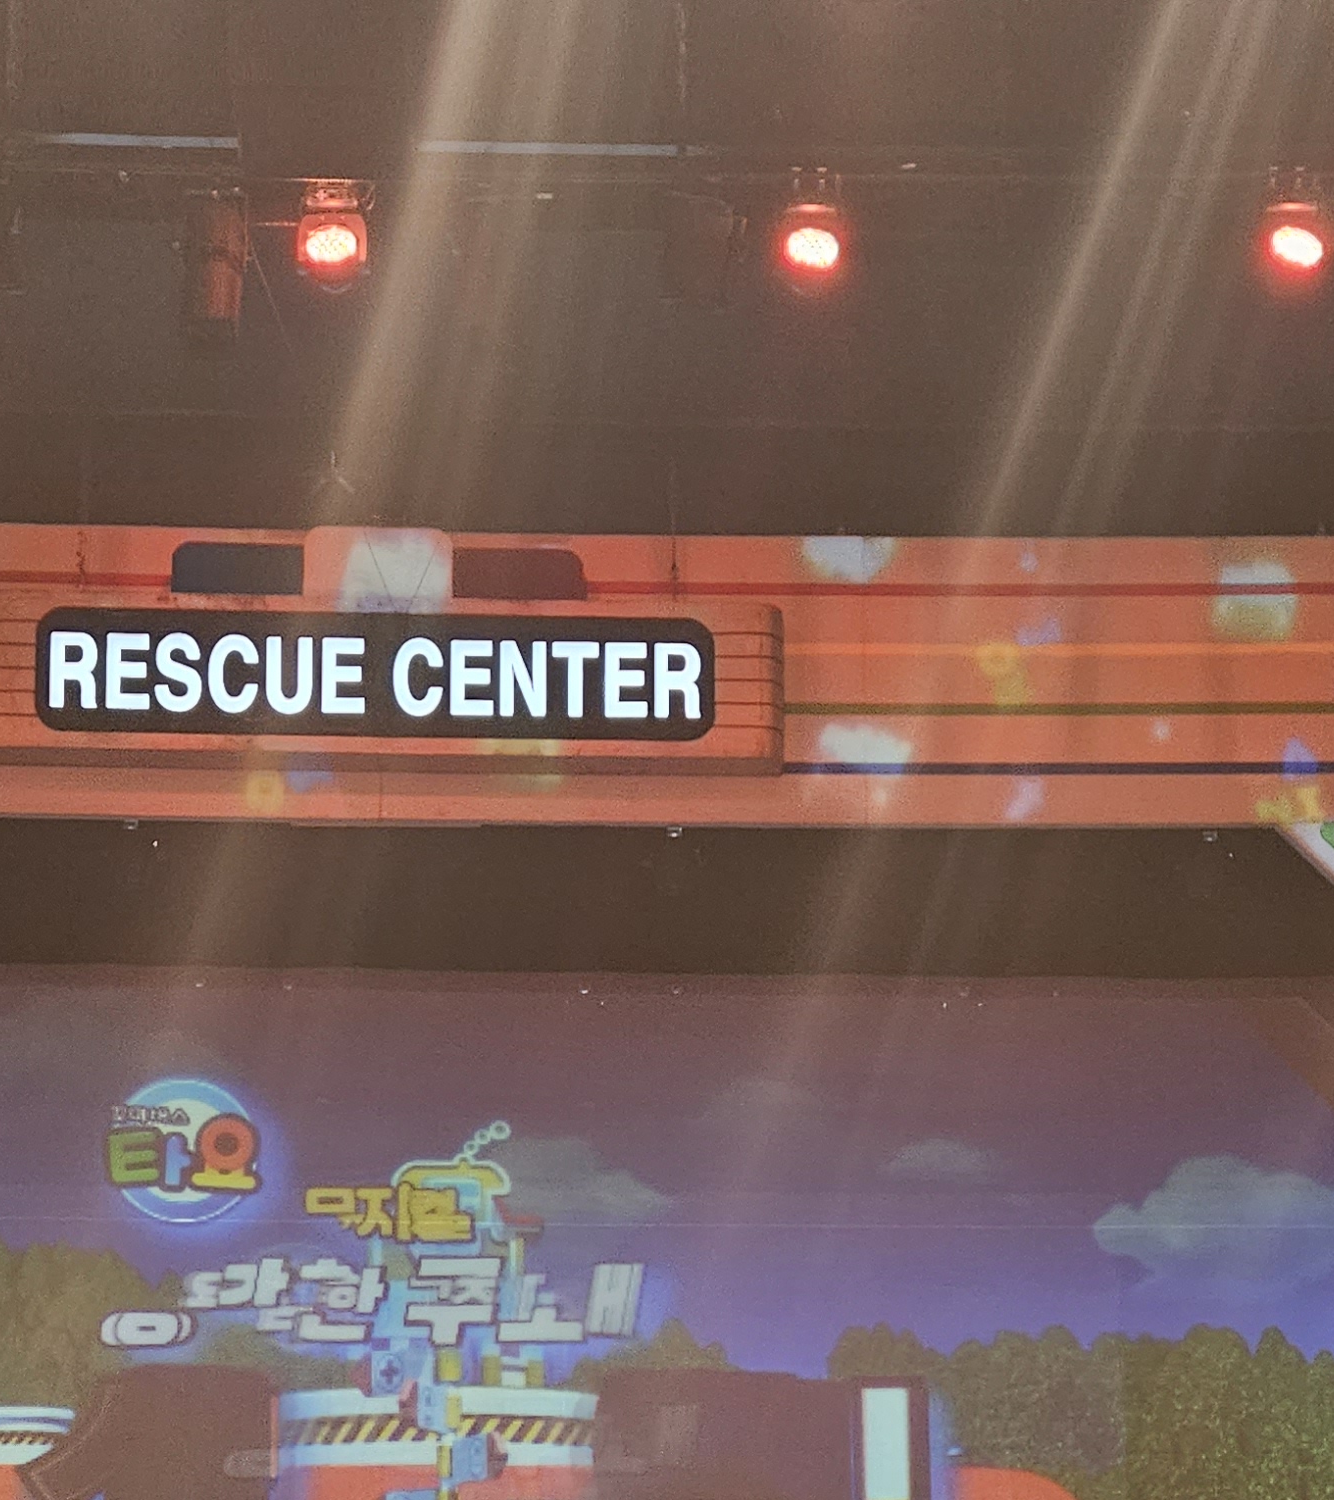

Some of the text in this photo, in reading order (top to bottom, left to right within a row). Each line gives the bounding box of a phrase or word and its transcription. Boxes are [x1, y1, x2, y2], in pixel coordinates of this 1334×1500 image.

[48, 629, 703, 721] RESCUE CENTER
[106, 1111, 260, 1193] 타요
